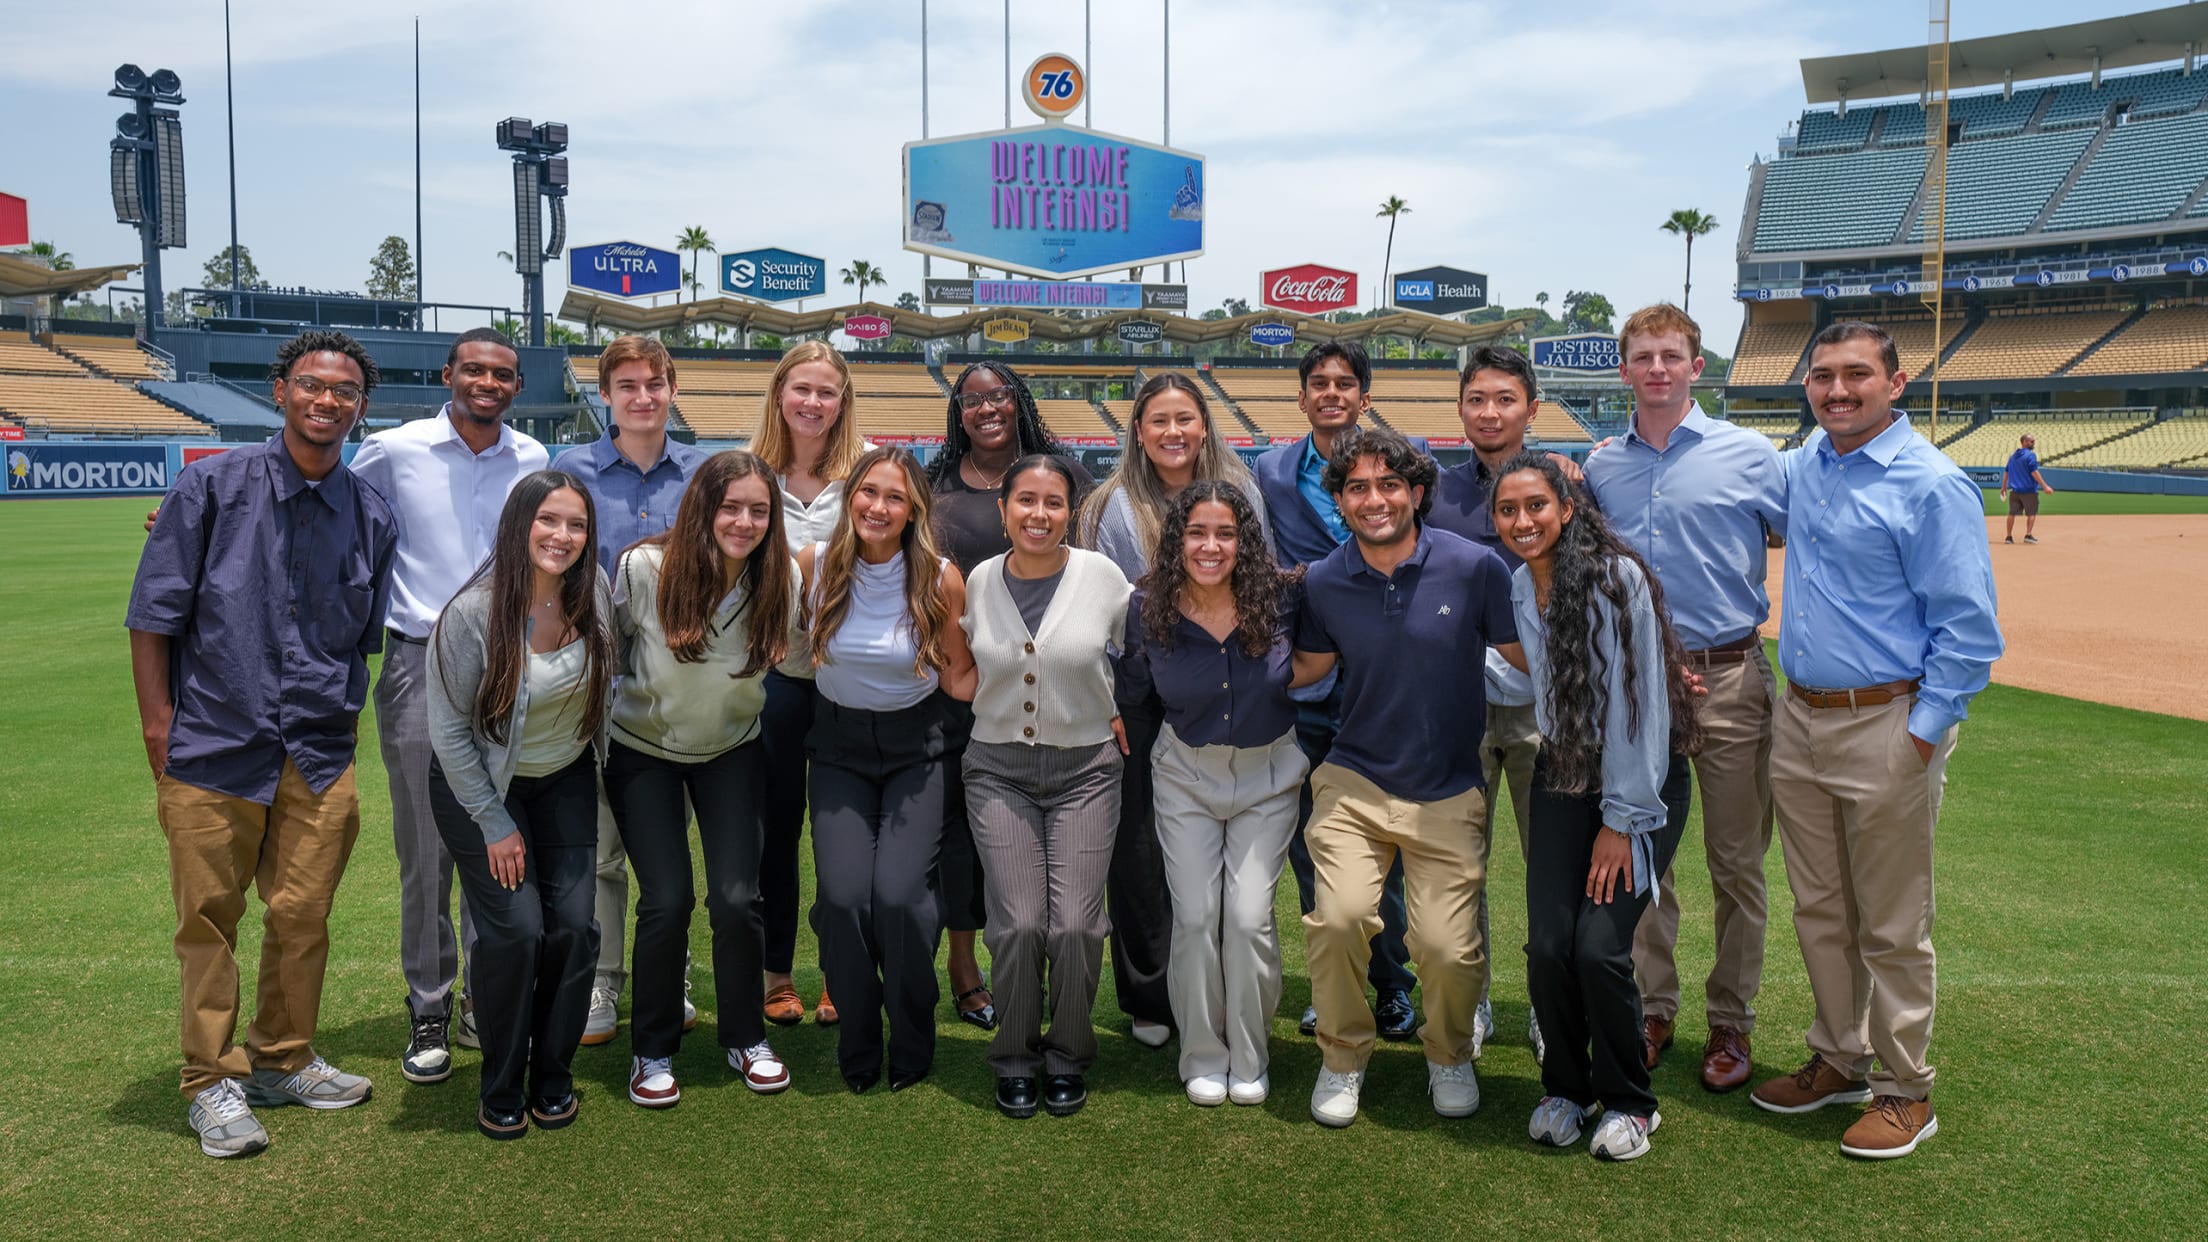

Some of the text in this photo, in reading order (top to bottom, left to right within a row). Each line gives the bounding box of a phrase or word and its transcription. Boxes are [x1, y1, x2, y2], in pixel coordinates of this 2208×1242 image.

[1039, 70, 1074, 99] 76
[991, 141, 1129, 190] WELCOME
[991, 186, 1129, 233] INTERNS!
[603, 244, 649, 257] Michelob
[594, 256, 658, 273] ULTRA
[761, 259, 817, 278] Security
[2135, 266, 2159, 275] 1988
[763, 275, 810, 292] Benefit
[2060, 273, 2080, 281] 1981
[980, 283, 1040, 304] WELCOME
[1271, 275, 1350, 302] Coca-Cola
[1400, 283, 1481, 298] UCLA Health
[1776, 290, 1797, 298] 1955
[1843, 287, 1865, 296] 1959
[1913, 283, 1935, 291] 1963
[847, 323, 877, 332] DAISO
[987, 321, 1025, 337] JIM BEAM
[1121, 326, 1159, 334] STARLUX
[1253, 328, 1292, 336] MORTON
[1543, 354, 1621, 367] JALISCO
[33, 461, 165, 488] MORTON
